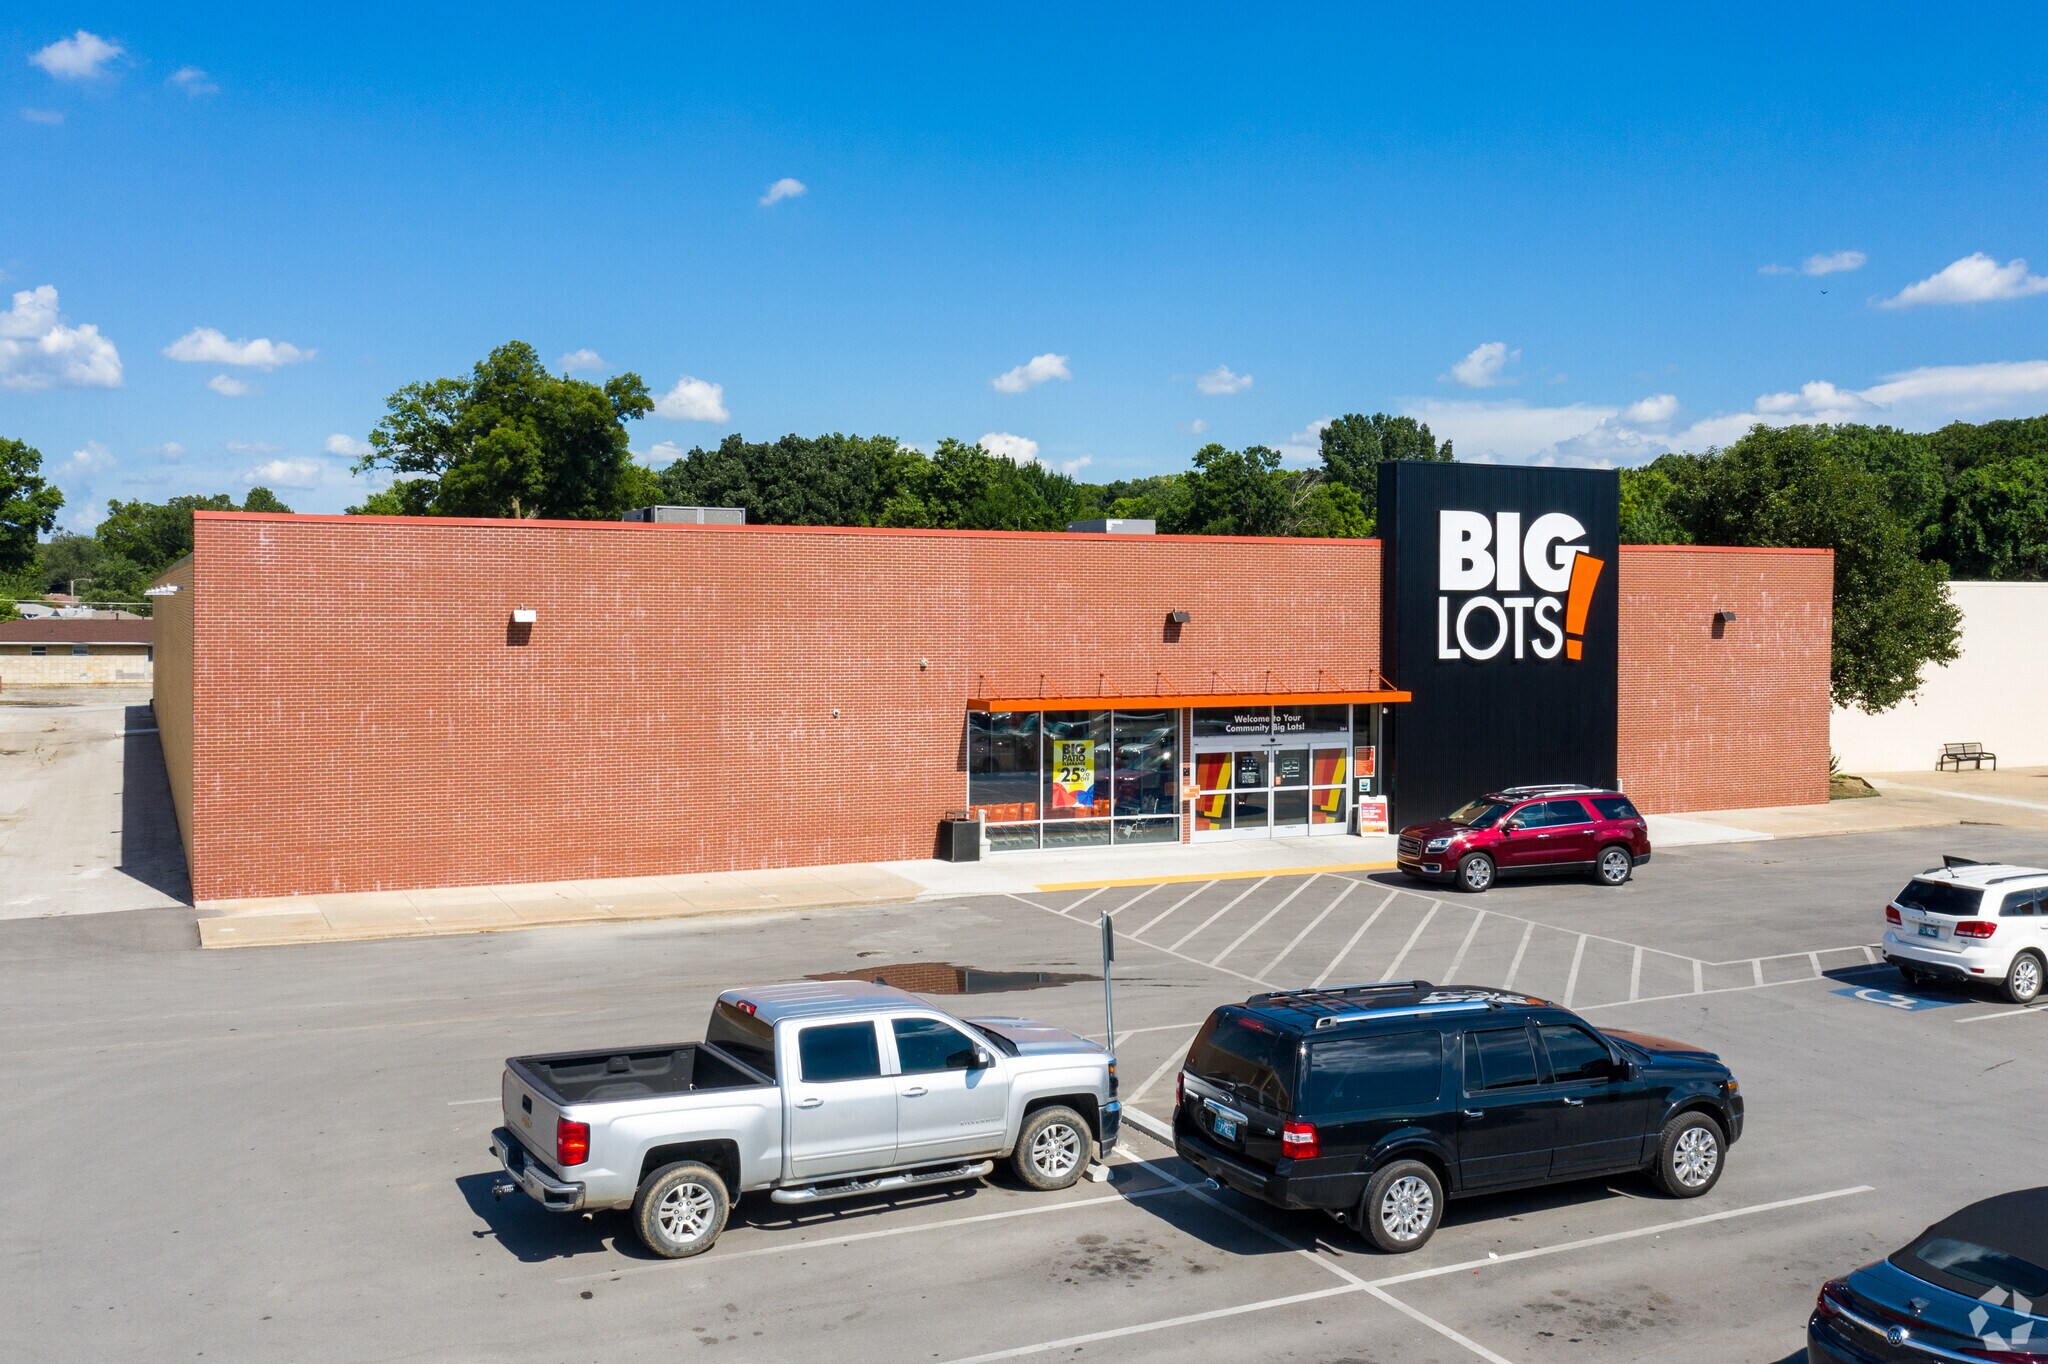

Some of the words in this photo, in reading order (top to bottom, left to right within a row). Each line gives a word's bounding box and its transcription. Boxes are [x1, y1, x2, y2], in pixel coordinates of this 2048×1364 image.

[1440, 510, 1590, 592] BIG
[1234, 715, 1269, 723] Welcome
[1226, 724, 1269, 733] Community
[1273, 723, 1285, 732] Big
[1287, 722, 1305, 731] Lots!
[1062, 744, 1086, 754] BIG
[1062, 754, 1085, 762] PATIO
